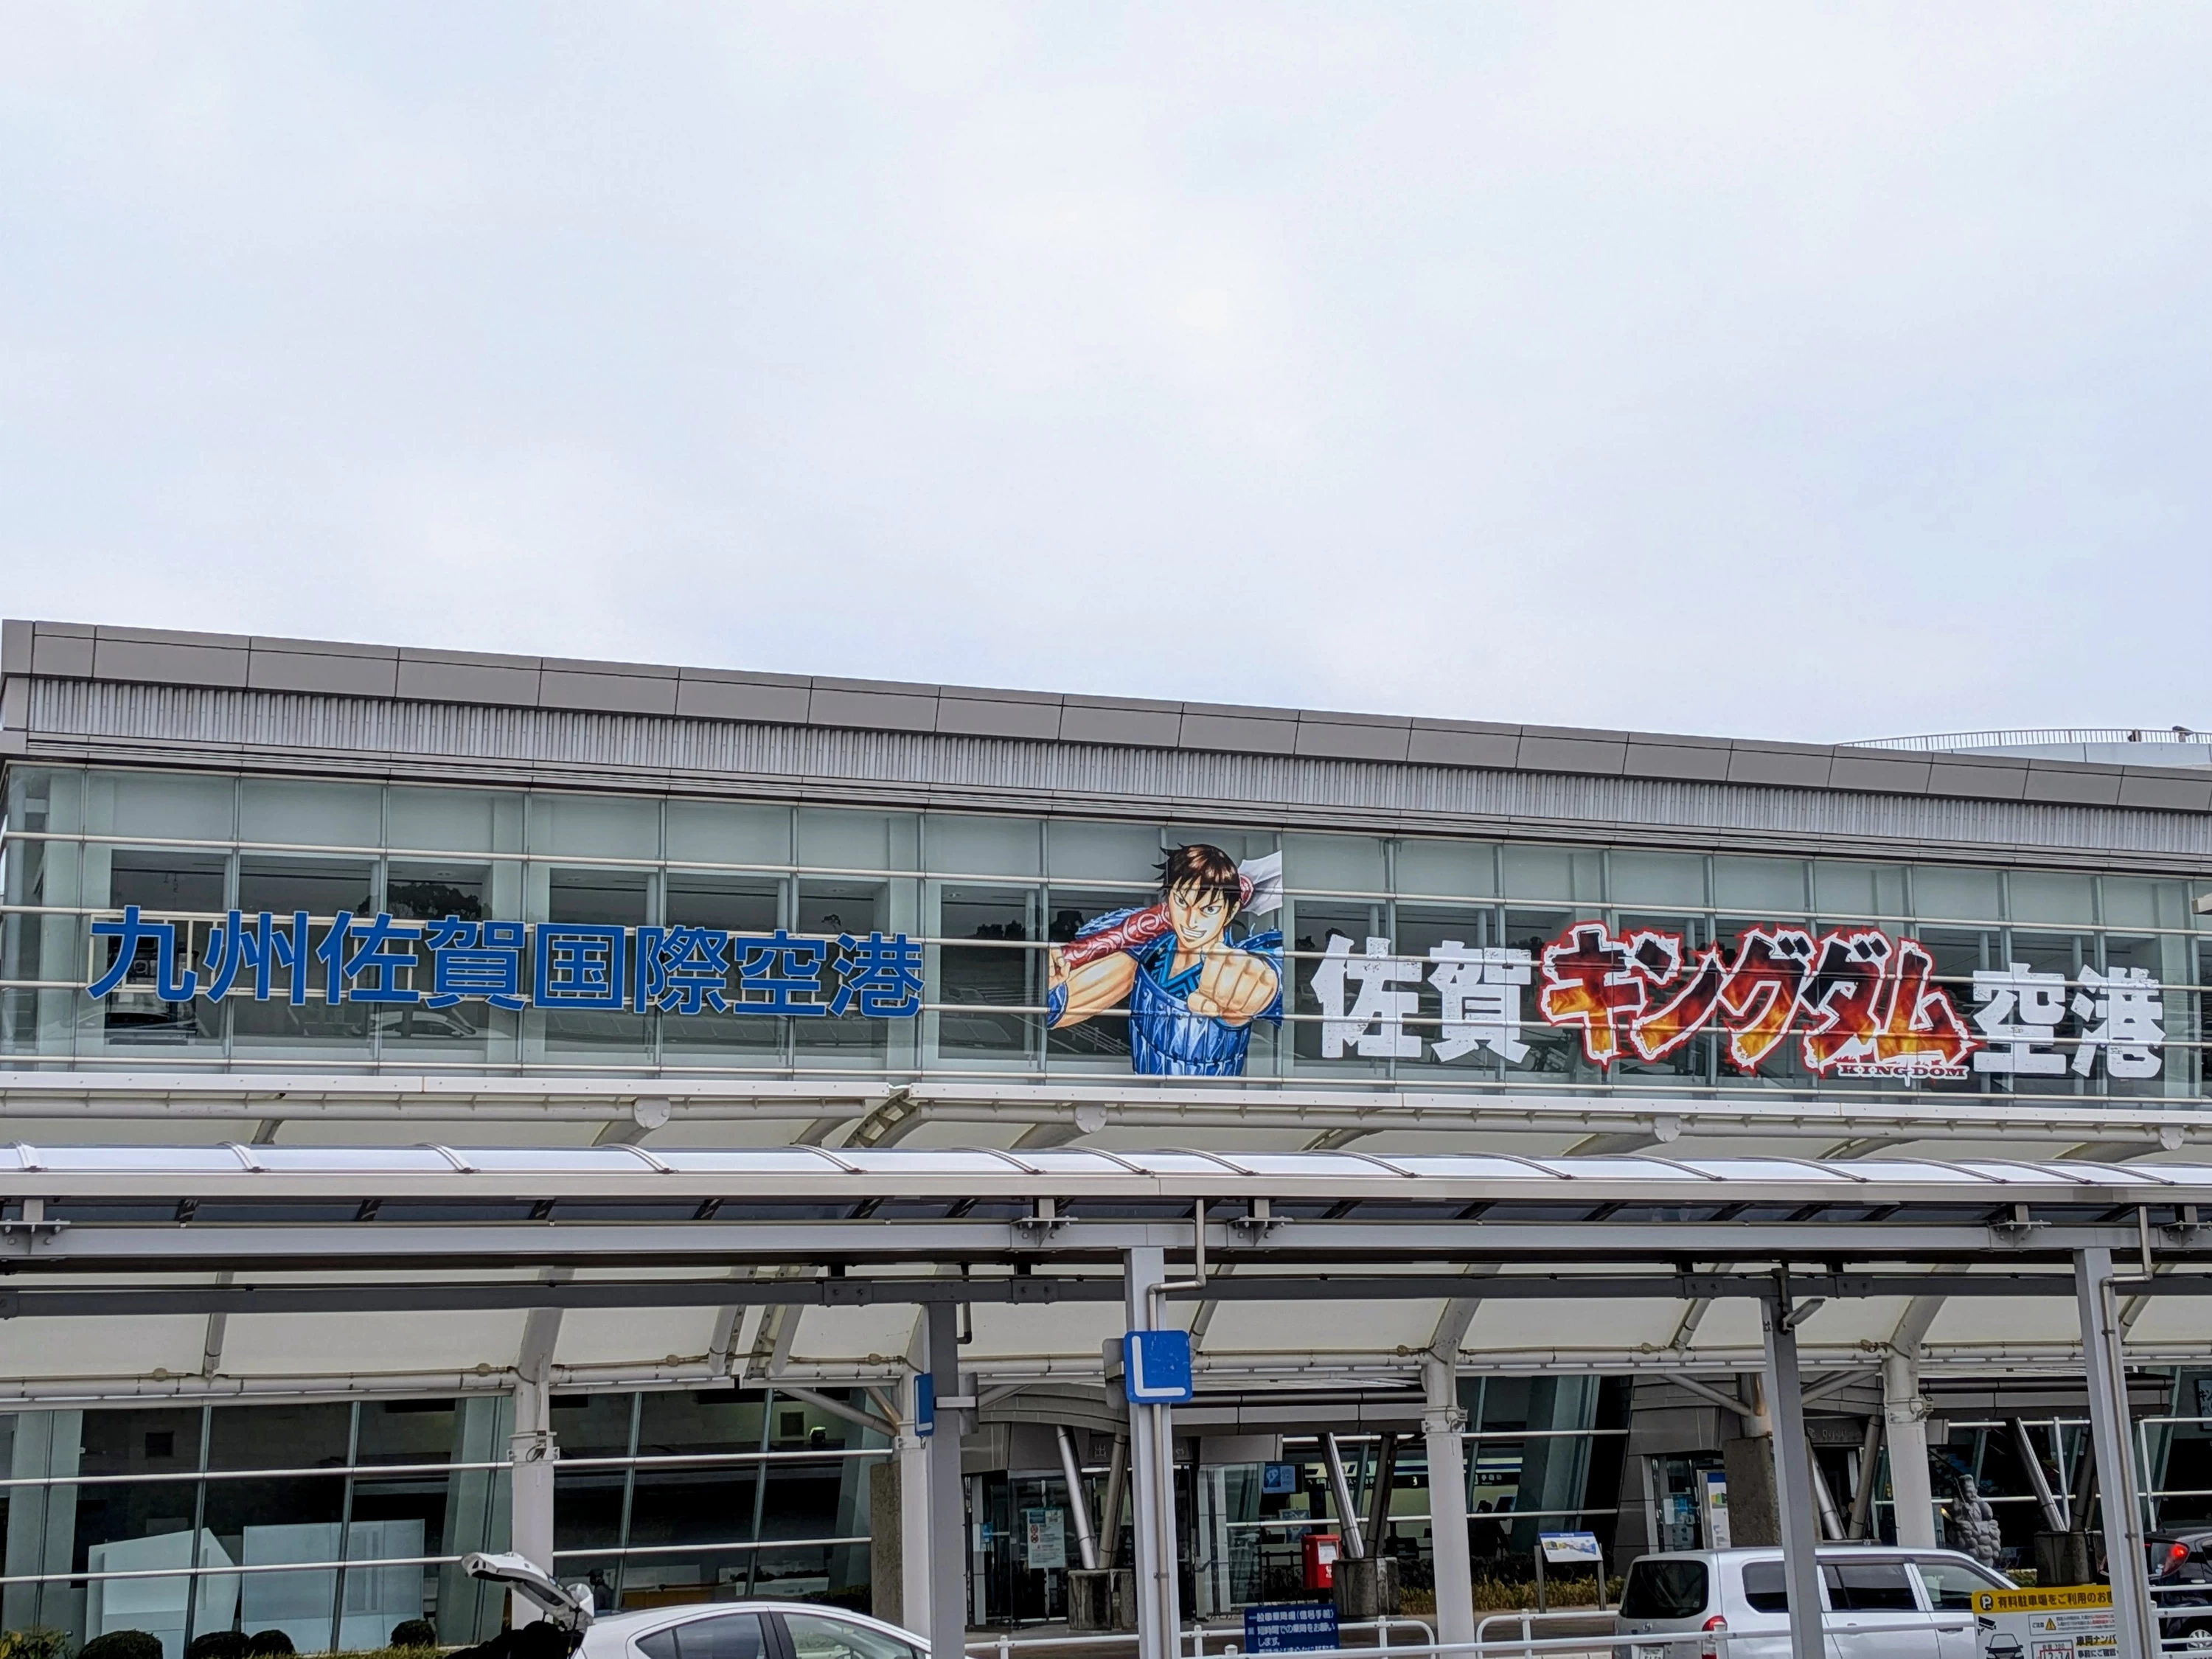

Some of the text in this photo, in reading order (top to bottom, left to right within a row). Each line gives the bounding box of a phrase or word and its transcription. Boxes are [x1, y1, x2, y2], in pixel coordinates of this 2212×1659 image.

[87, 905, 925, 1018] 九州佐賀国際空港
[1840, 1062, 1966, 1077] KINGDOM
